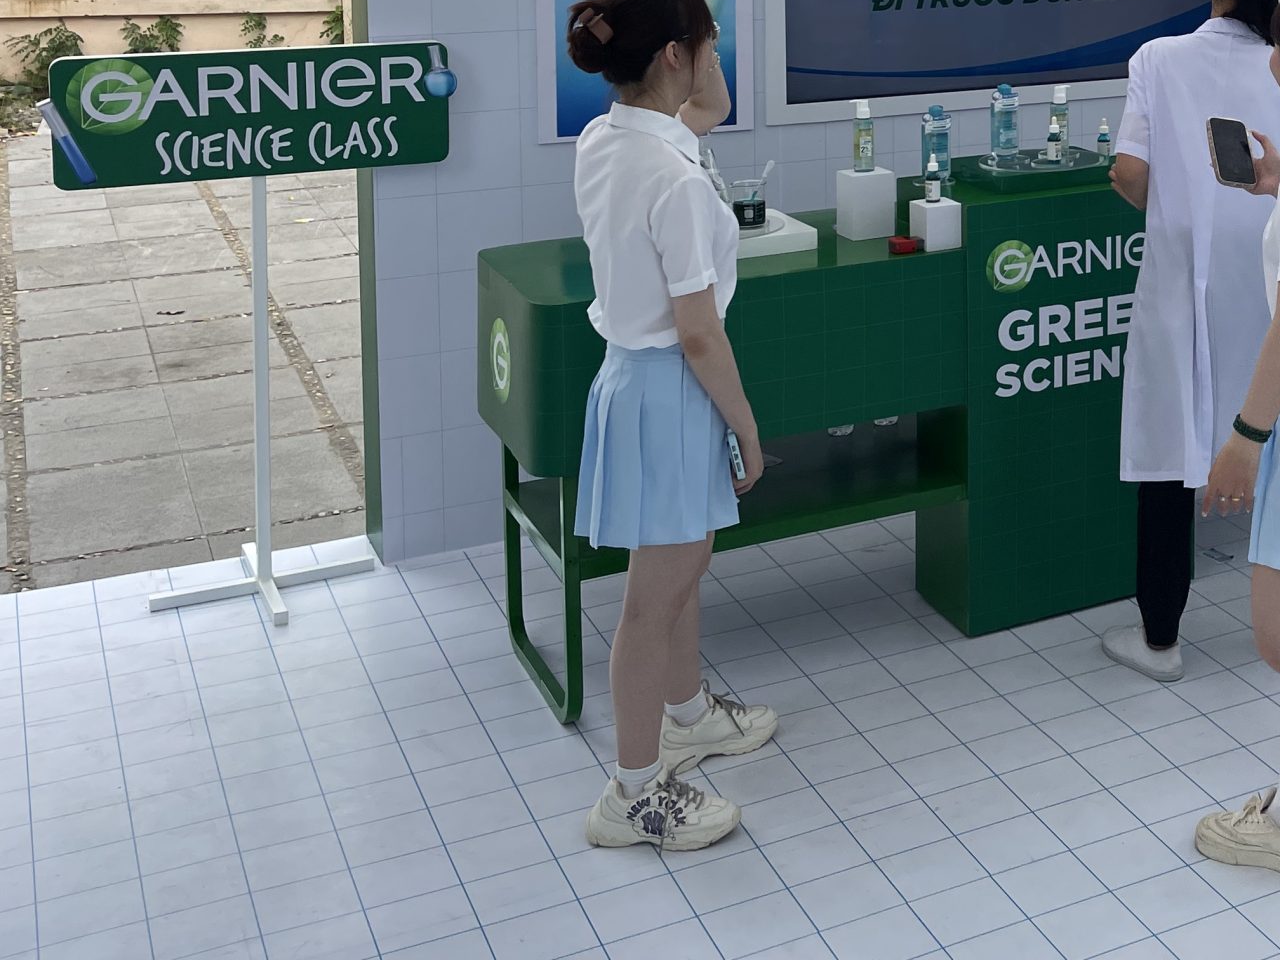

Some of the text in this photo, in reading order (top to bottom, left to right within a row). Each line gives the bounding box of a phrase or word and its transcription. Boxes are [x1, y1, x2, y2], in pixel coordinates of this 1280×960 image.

[155, 115, 399, 176] SCIENCE CLASS
[993, 232, 1146, 286] GARNIE
[997, 292, 1138, 352] GREE
[994, 345, 1126, 398] SCIEN
[626, 796, 651, 822] NEW
